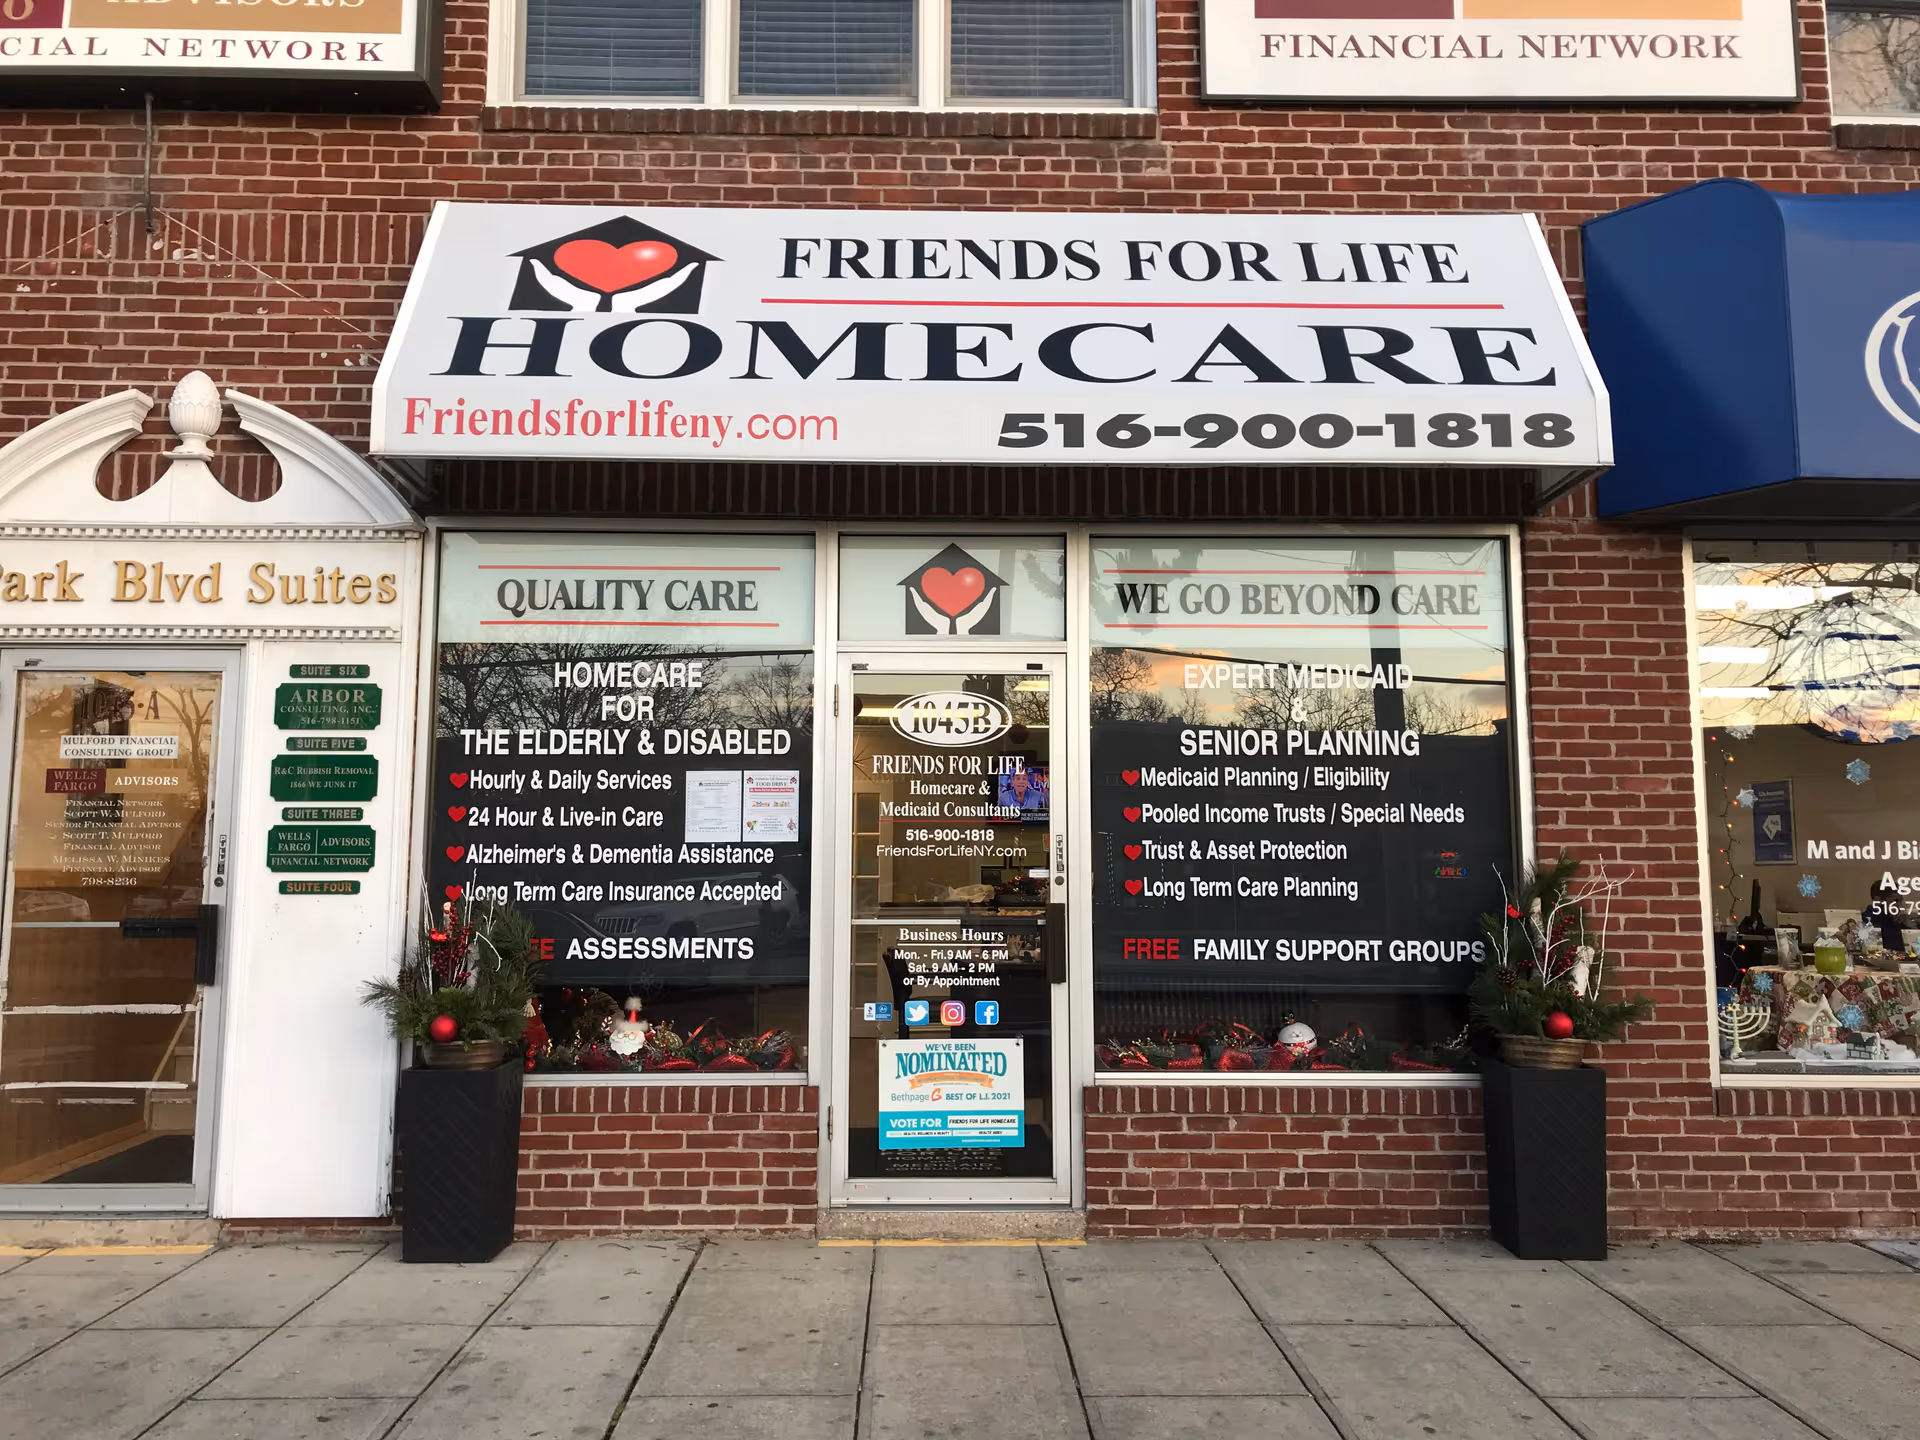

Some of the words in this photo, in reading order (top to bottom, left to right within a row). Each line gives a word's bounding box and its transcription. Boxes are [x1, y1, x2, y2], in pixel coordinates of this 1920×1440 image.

[141, 38, 383, 62] NETWORK
[1260, 34, 1503, 58] FINANCIAL
[1518, 34, 1742, 59] NETWORK
[777, 238, 1100, 281] FRIENDS
[1120, 240, 1282, 282] FOR
[1292, 242, 1469, 283] LIFE
[430, 316, 1556, 386] HOMECARE
[402, 398, 838, 448] Friendsforlifeny.com
[998, 413, 1575, 449] 516-900-1818
[0, 559, 84, 603] ark
[112, 559, 223, 603] Blvd
[248, 561, 397, 604] Suites
[496, 578, 655, 618] QUALITY
[664, 580, 758, 611] CARE
[1114, 583, 1170, 614] WE
[1180, 583, 1230, 615] GO
[1240, 583, 1380, 616] BEYOND
[1392, 584, 1480, 615] CARE
[301, 666, 331, 676] SUITE
[339, 666, 357, 676] SIX
[554, 662, 702, 688] HOMECARE
[1184, 664, 1278, 689] EXPERT
[1287, 664, 1413, 690] MEDICAID
[290, 689, 366, 702] ARBOR
[280, 706, 349, 714] CONSULTING,
[601, 696, 654, 721] FOR
[910, 701, 991, 734] 1045B
[1290, 696, 1308, 722] &
[63, 738, 116, 746] MULFORD
[120, 738, 176, 746] FINANCIAL
[297, 739, 328, 748] SUITE
[332, 739, 355, 748] FIVE
[460, 729, 509, 755] THE
[519, 729, 631, 755] ELDERLY
[638, 730, 656, 756] &
[664, 730, 791, 756] DISABLED
[1180, 729, 1278, 756] SENIOR
[1287, 730, 1420, 756] PLANNING
[64, 748, 132, 756] CONSULTING
[136, 748, 174, 757] GROUP
[274, 766, 294, 775] R&C
[872, 755, 944, 774] FRIENDS
[949, 756, 982, 774] FOR
[987, 756, 1026, 774] LIFE
[54, 771, 98, 780] WELLS
[115, 776, 178, 786] ADVISORS
[470, 770, 526, 794] Hourly
[530, 770, 544, 790] &
[548, 770, 591, 794] Daily
[597, 770, 672, 790] Services
[1141, 767, 1218, 788] Medicaid
[1224, 767, 1298, 790] Planning
[1314, 767, 1390, 790] Eligibility
[54, 782, 97, 791] FARGO
[910, 780, 975, 795] Homecare
[978, 780, 990, 795] &
[288, 809, 318, 818] SUITE
[322, 809, 357, 818] THREE
[468, 806, 490, 826] 24
[496, 806, 537, 827] Hour
[542, 806, 554, 827] &
[560, 806, 617, 827] Live-in
[622, 806, 664, 828] Care
[880, 802, 940, 816] Medicaid
[944, 802, 1020, 816] Consultants
[1142, 804, 1200, 823] Pooled
[1205, 804, 1269, 823] Income
[1273, 804, 1326, 823] Trusts
[1341, 804, 1404, 827] Special
[1410, 804, 1464, 824] Needs
[278, 832, 311, 840] WELLS
[320, 838, 370, 846] ADVISORS
[906, 829, 994, 842] 516-900-1818
[278, 844, 310, 852] FARGO
[465, 844, 566, 864] Alzheimer's
[572, 844, 584, 864] &
[590, 844, 673, 864] Dementia
[678, 844, 775, 864] Assistance
[876, 845, 1026, 857] FriendsForLifeNY.com
[1142, 840, 1184, 860] Trust
[1189, 840, 1202, 860] &
[1206, 840, 1255, 860] Asset
[1260, 840, 1348, 860] Protection
[1808, 840, 1830, 860] M
[1835, 840, 1876, 860] and
[1881, 840, 1891, 860] J
[272, 858, 320, 866] FINANCIAL
[324, 858, 369, 866] NETWORK
[81, 878, 137, 886] 798-8236
[286, 882, 320, 892] SUITE
[324, 882, 352, 892] FOUR
[1144, 878, 1185, 901] Long
[1190, 878, 1232, 896] Term
[1237, 878, 1279, 896] Care
[1284, 877, 1358, 901] Planning
[466, 882, 508, 906] Long
[514, 882, 556, 902] Term
[562, 882, 602, 902] Care
[608, 882, 696, 902] Insurance
[700, 882, 782, 905] Accepted
[900, 928, 958, 941] Business
[962, 928, 1004, 941] Hours
[566, 937, 754, 960] ASSESSMENTS
[894, 950, 920, 960] Mon.
[982, 950, 988, 960] 6
[992, 950, 1008, 960] PM
[1124, 938, 1180, 960] FREE
[1194, 938, 1270, 961] FAMILY
[1276, 939, 1382, 962] SUPPORT
[1390, 940, 1486, 963] GROUPS
[908, 963, 929, 972] Sat.
[932, 963, 938, 972] 9
[941, 963, 958, 972] AM
[968, 963, 975, 972] 2
[979, 963, 995, 972] PM
[917, 976, 930, 988] By
[933, 976, 1000, 988] Appointment
[896, 1052, 1007, 1079] NOMINATED
[891, 1093, 930, 1102] Bethpage
[890, 1118, 918, 1128] VOTE
[920, 1118, 942, 1128] FOR
